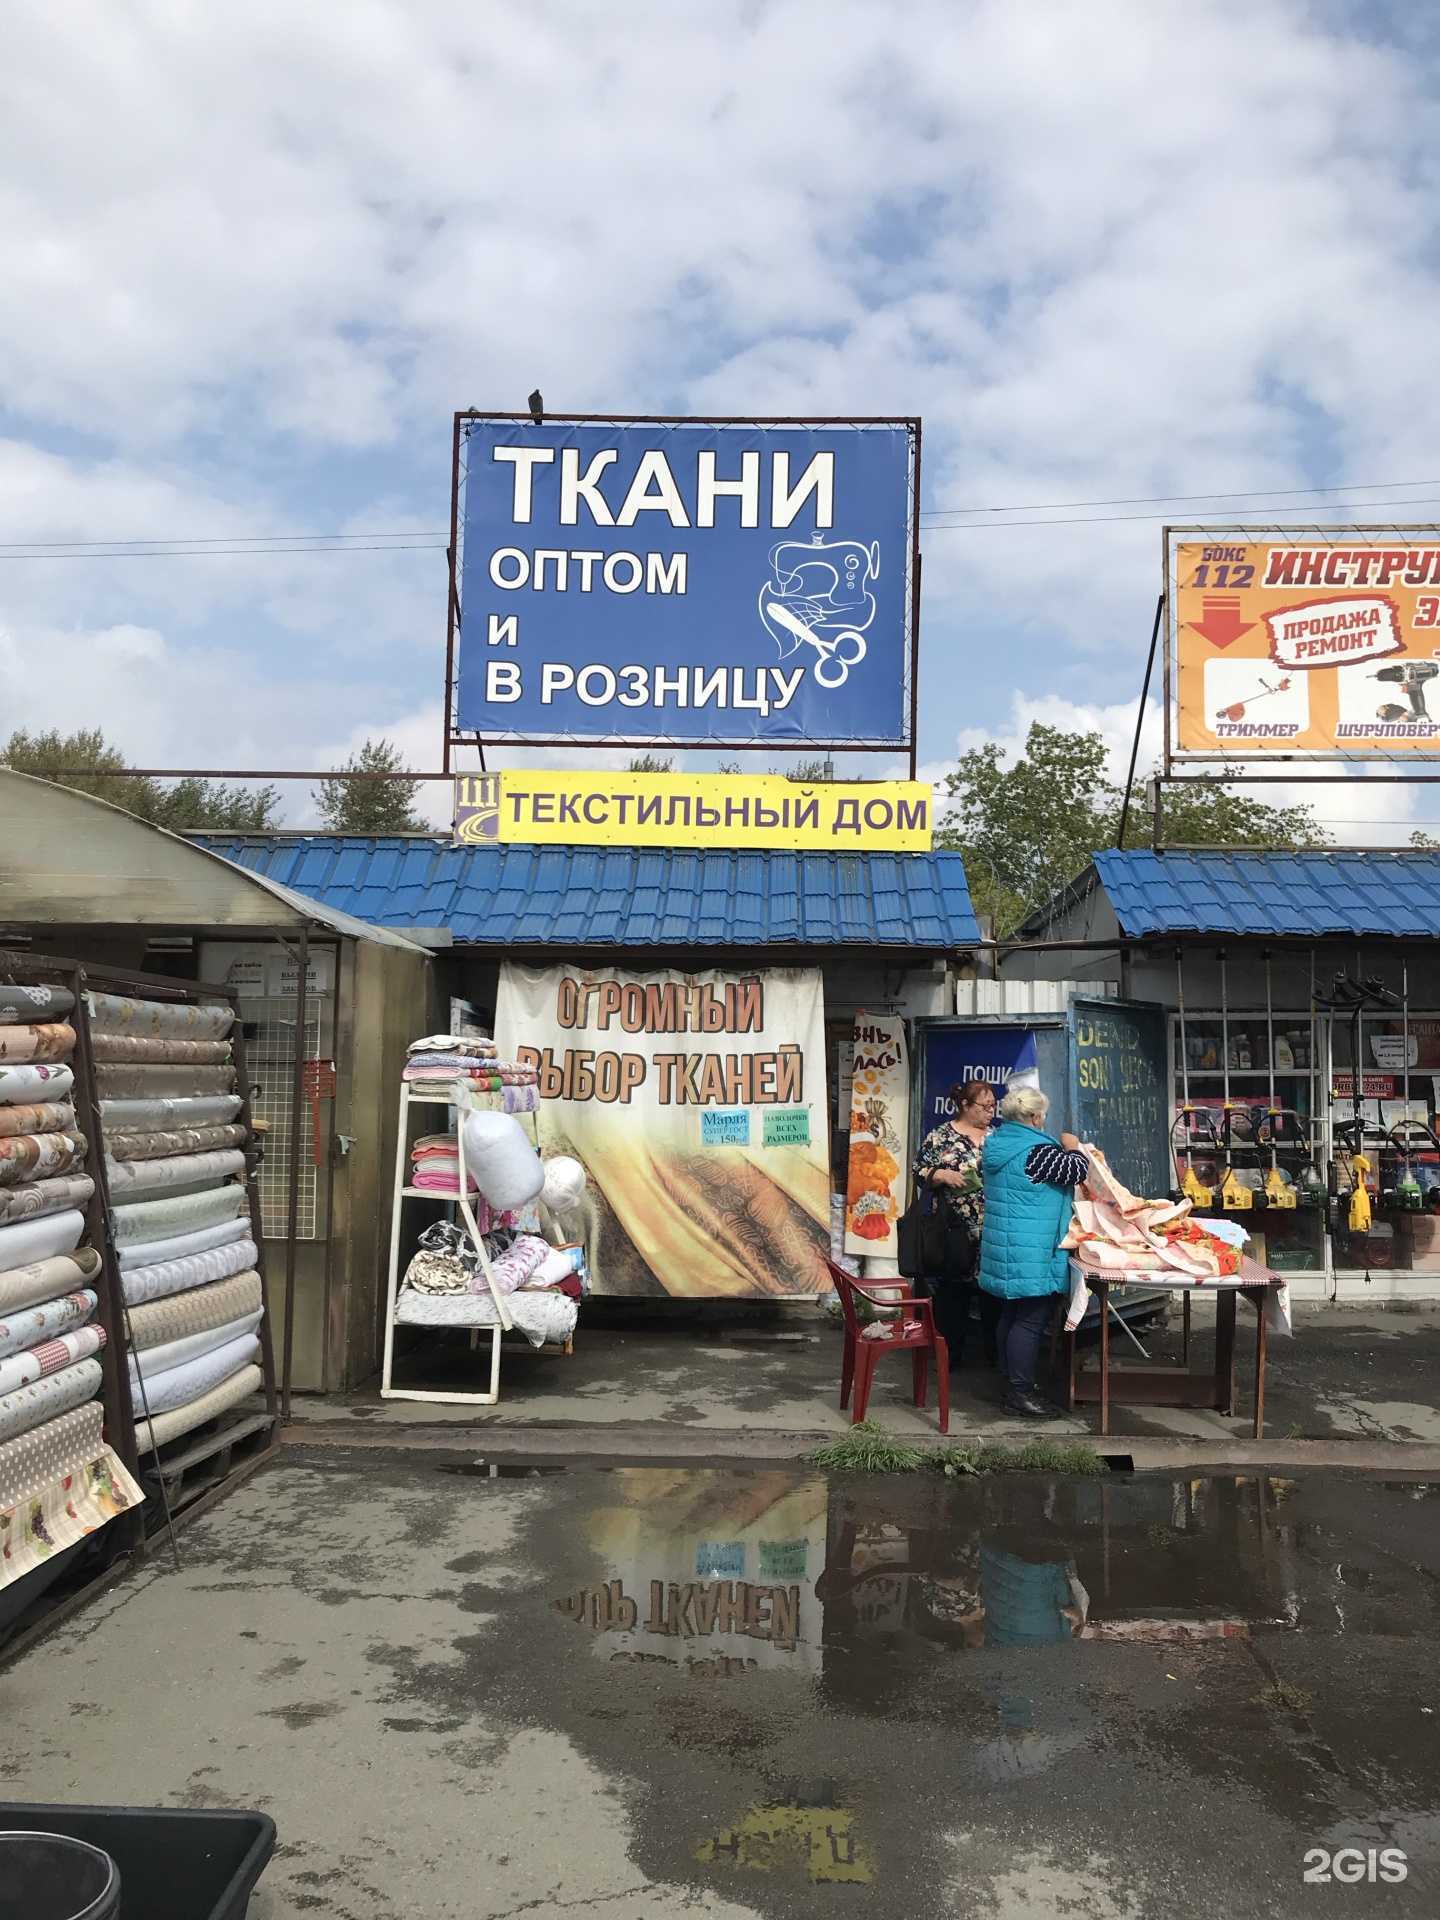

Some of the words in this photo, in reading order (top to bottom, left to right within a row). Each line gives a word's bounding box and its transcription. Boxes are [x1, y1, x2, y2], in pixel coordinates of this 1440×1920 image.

[493, 446, 836, 528] ТКАНИ
[488, 547, 688, 595] ОПТОМ
[1192, 565, 1256, 588] 112
[1201, 547, 1246, 562] БОКС
[1283, 608, 1382, 640] ПРОДАЖА
[1295, 629, 1377, 659] РЕМОНТ
[486, 661, 523, 703] В
[541, 664, 805, 717] РОЗНИЦУ
[1216, 723, 1299, 737] ТРИММЕР
[506, 791, 819, 829] ТЕКСТИЛЬНЫЙ
[832, 800, 927, 836] ДОМ
[557, 975, 764, 1033] ОГРОМНЫЙ
[653, 1044, 803, 1105] ТКАНЕЙ
